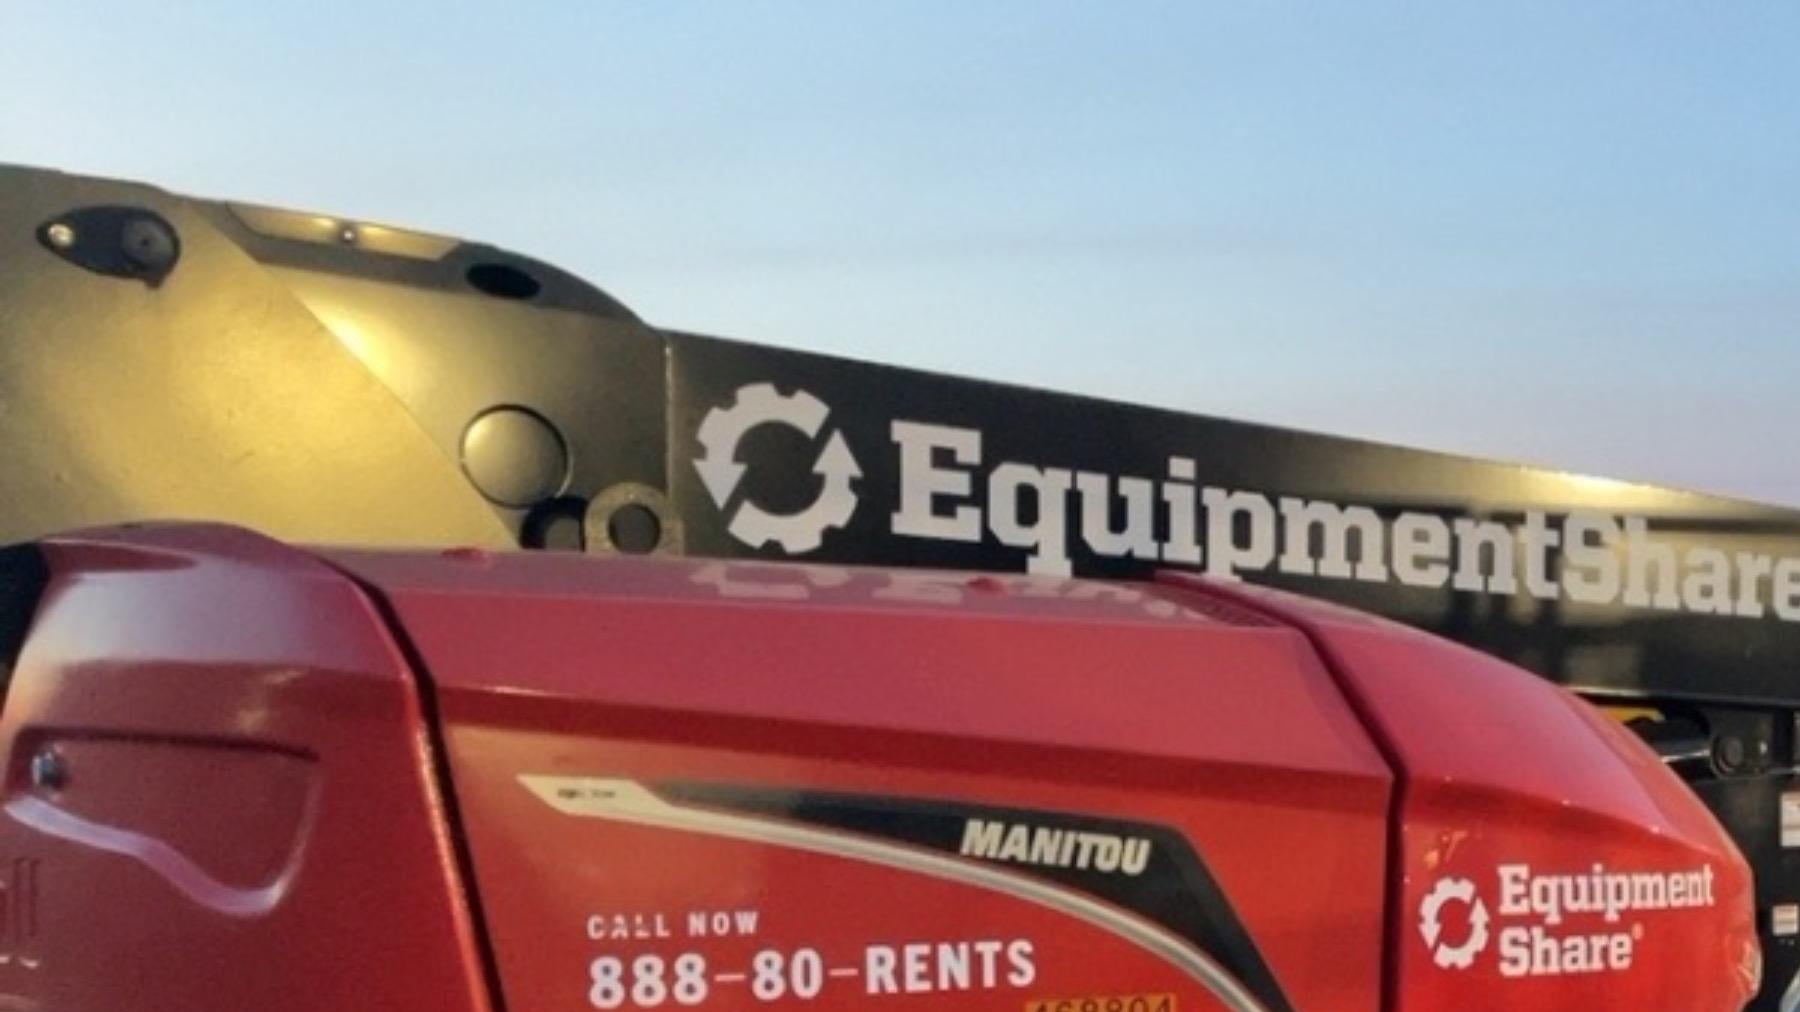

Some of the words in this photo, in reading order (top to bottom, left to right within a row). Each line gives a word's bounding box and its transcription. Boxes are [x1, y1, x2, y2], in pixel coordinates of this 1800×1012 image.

[960, 818, 1153, 877] MANITOU
[1497, 862, 1715, 921] Equipment
[587, 914, 671, 940] CALL
[688, 911, 760, 937] NOW
[588, 939, 1038, 1010] 888-80-RENTS
